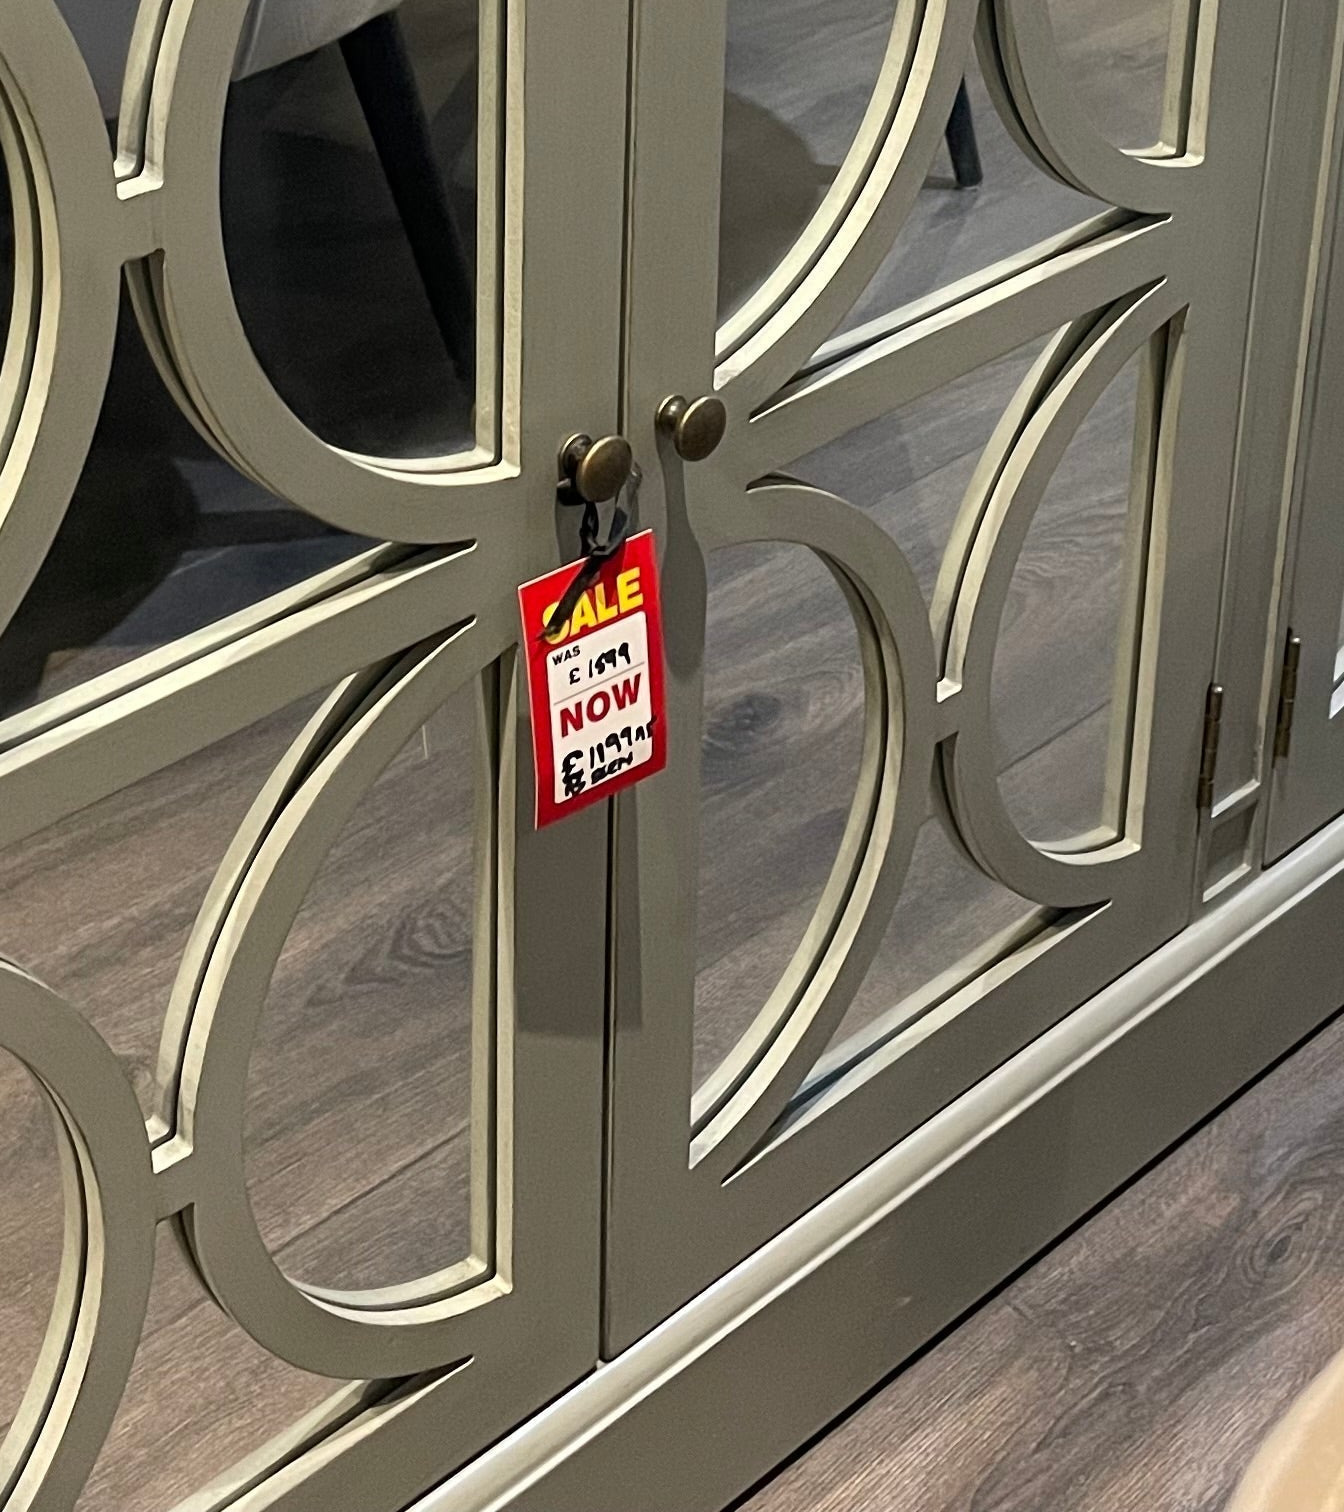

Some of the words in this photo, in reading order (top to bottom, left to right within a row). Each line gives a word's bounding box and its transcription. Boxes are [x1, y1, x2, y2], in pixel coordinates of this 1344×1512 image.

[542, 566, 644, 645] SALE
[552, 645, 581, 666] WAS
[560, 673, 642, 738] NOW
